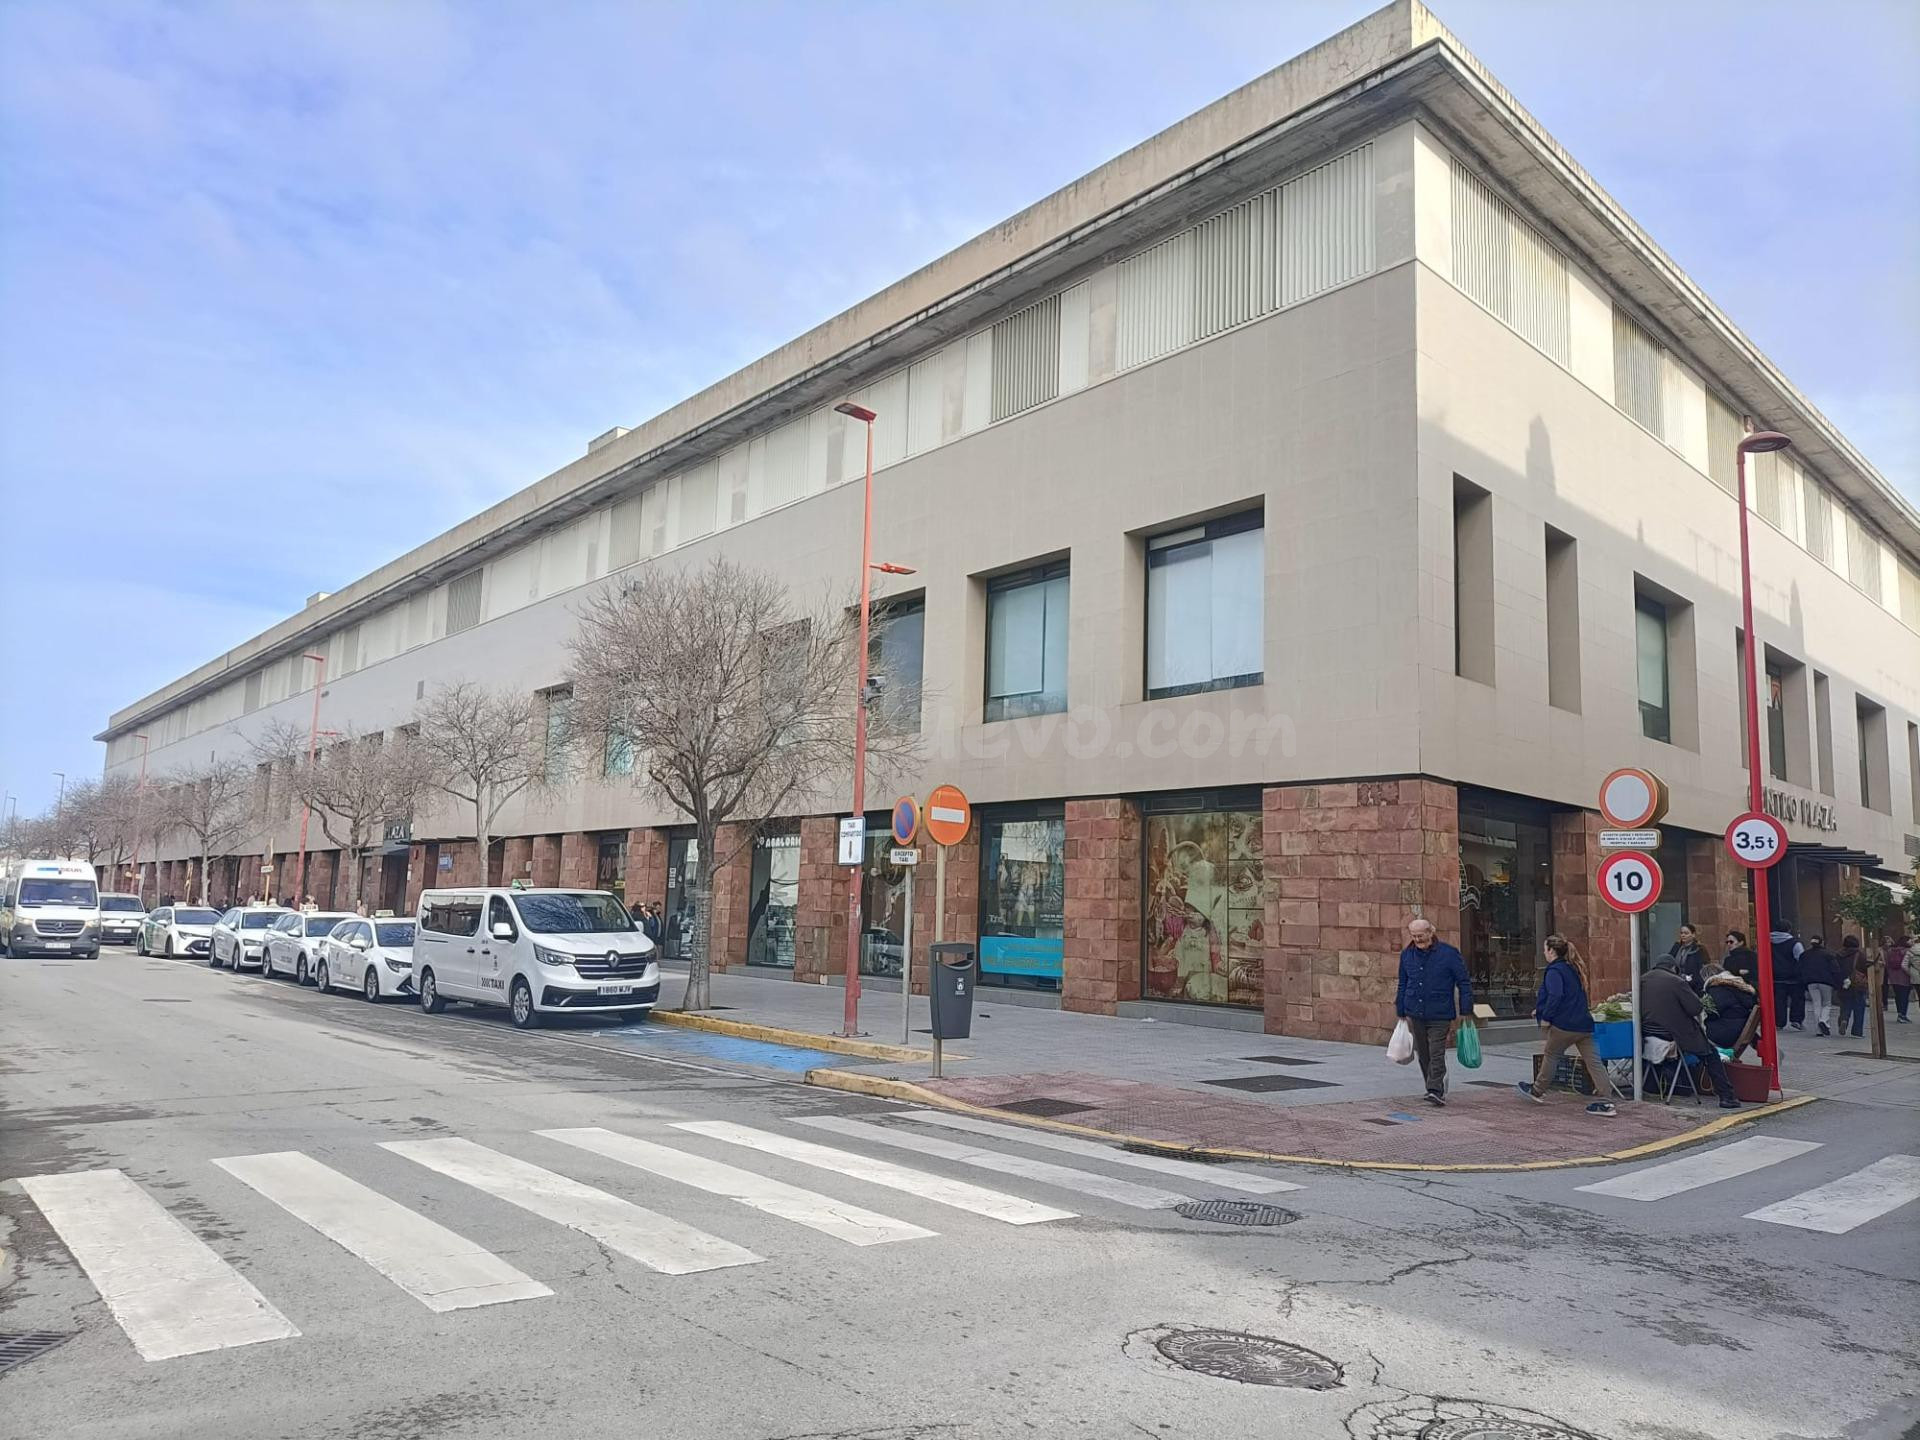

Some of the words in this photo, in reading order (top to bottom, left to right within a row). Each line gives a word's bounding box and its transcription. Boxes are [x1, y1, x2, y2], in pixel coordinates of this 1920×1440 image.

[1735, 831, 1765, 850] 3,5
[1767, 836, 1775, 849] t
[1613, 871, 1643, 891] 10
[492, 979, 505, 990] TAXI
